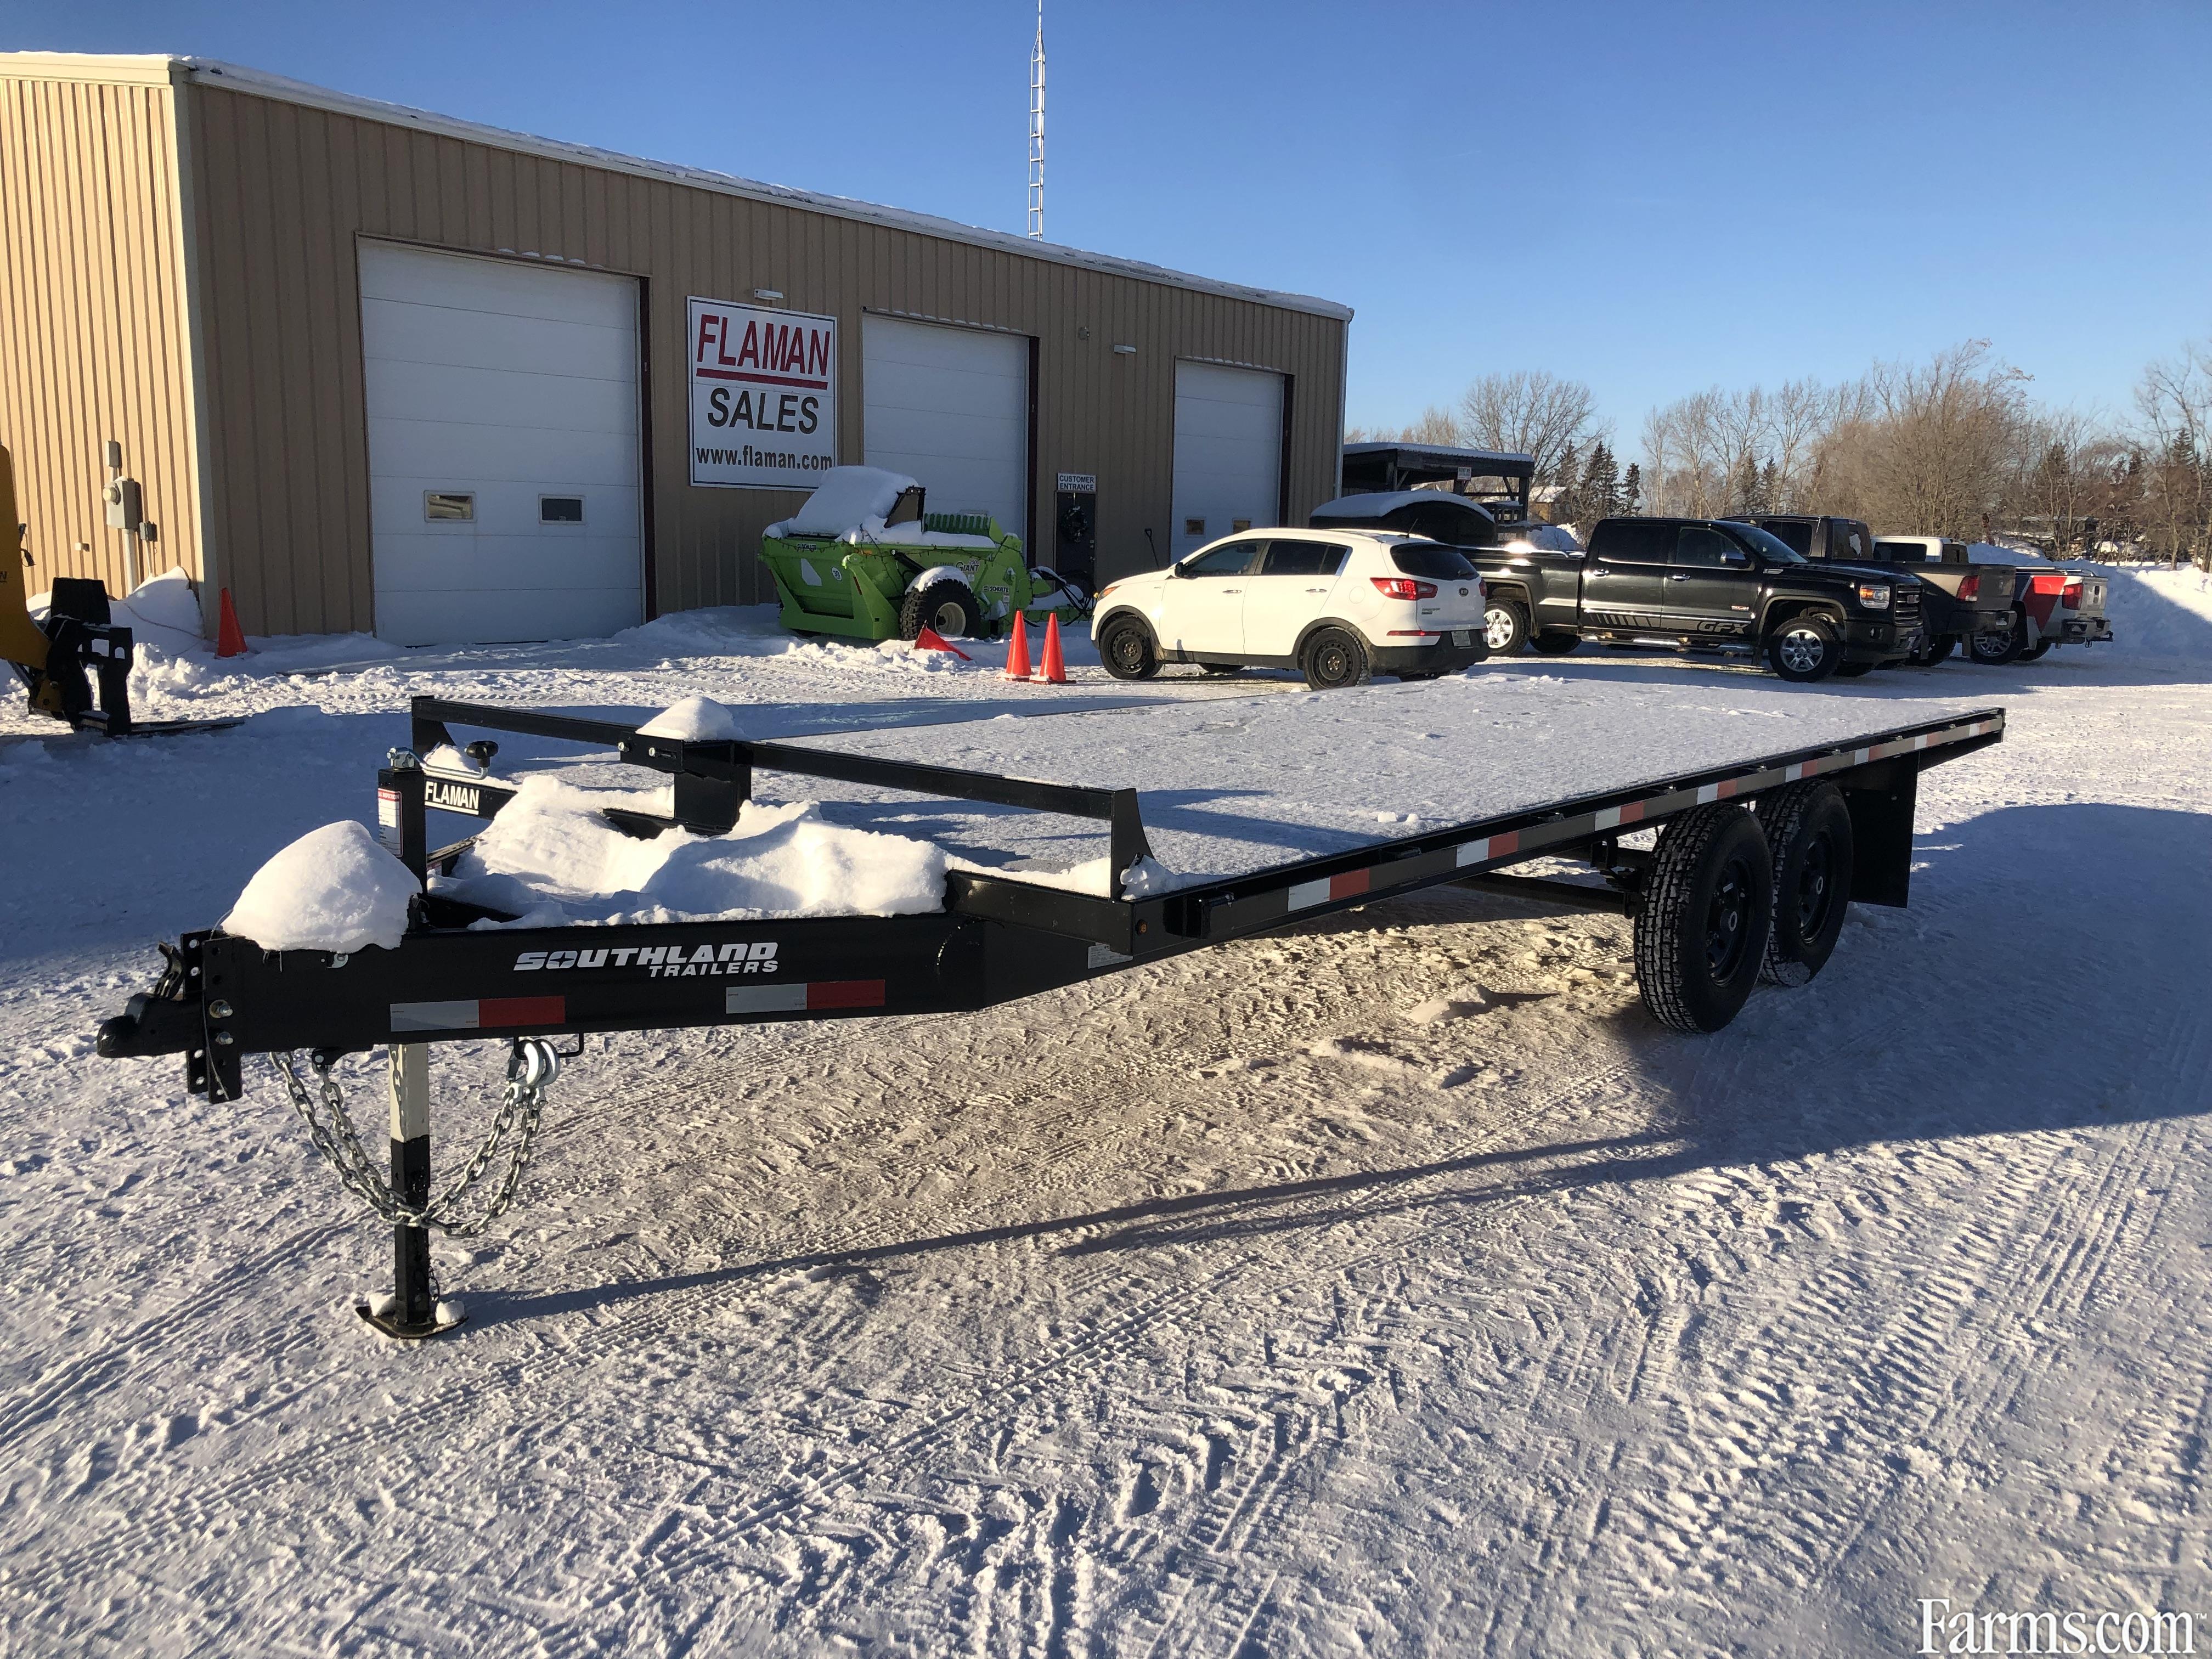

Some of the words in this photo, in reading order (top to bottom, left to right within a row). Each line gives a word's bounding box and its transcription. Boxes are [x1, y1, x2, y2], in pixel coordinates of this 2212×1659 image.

[697, 314, 831, 376] FLAMAN
[708, 387, 819, 435] SALES
[696, 445, 833, 471] www.flaman.com
[1060, 483, 1094, 491] ENTRANCE
[1698, 621, 1749, 635] GFX
[425, 781, 479, 810] FLAMAN
[513, 942, 778, 971] SOUTHLAND
[649, 960, 778, 978] TRAILERS
